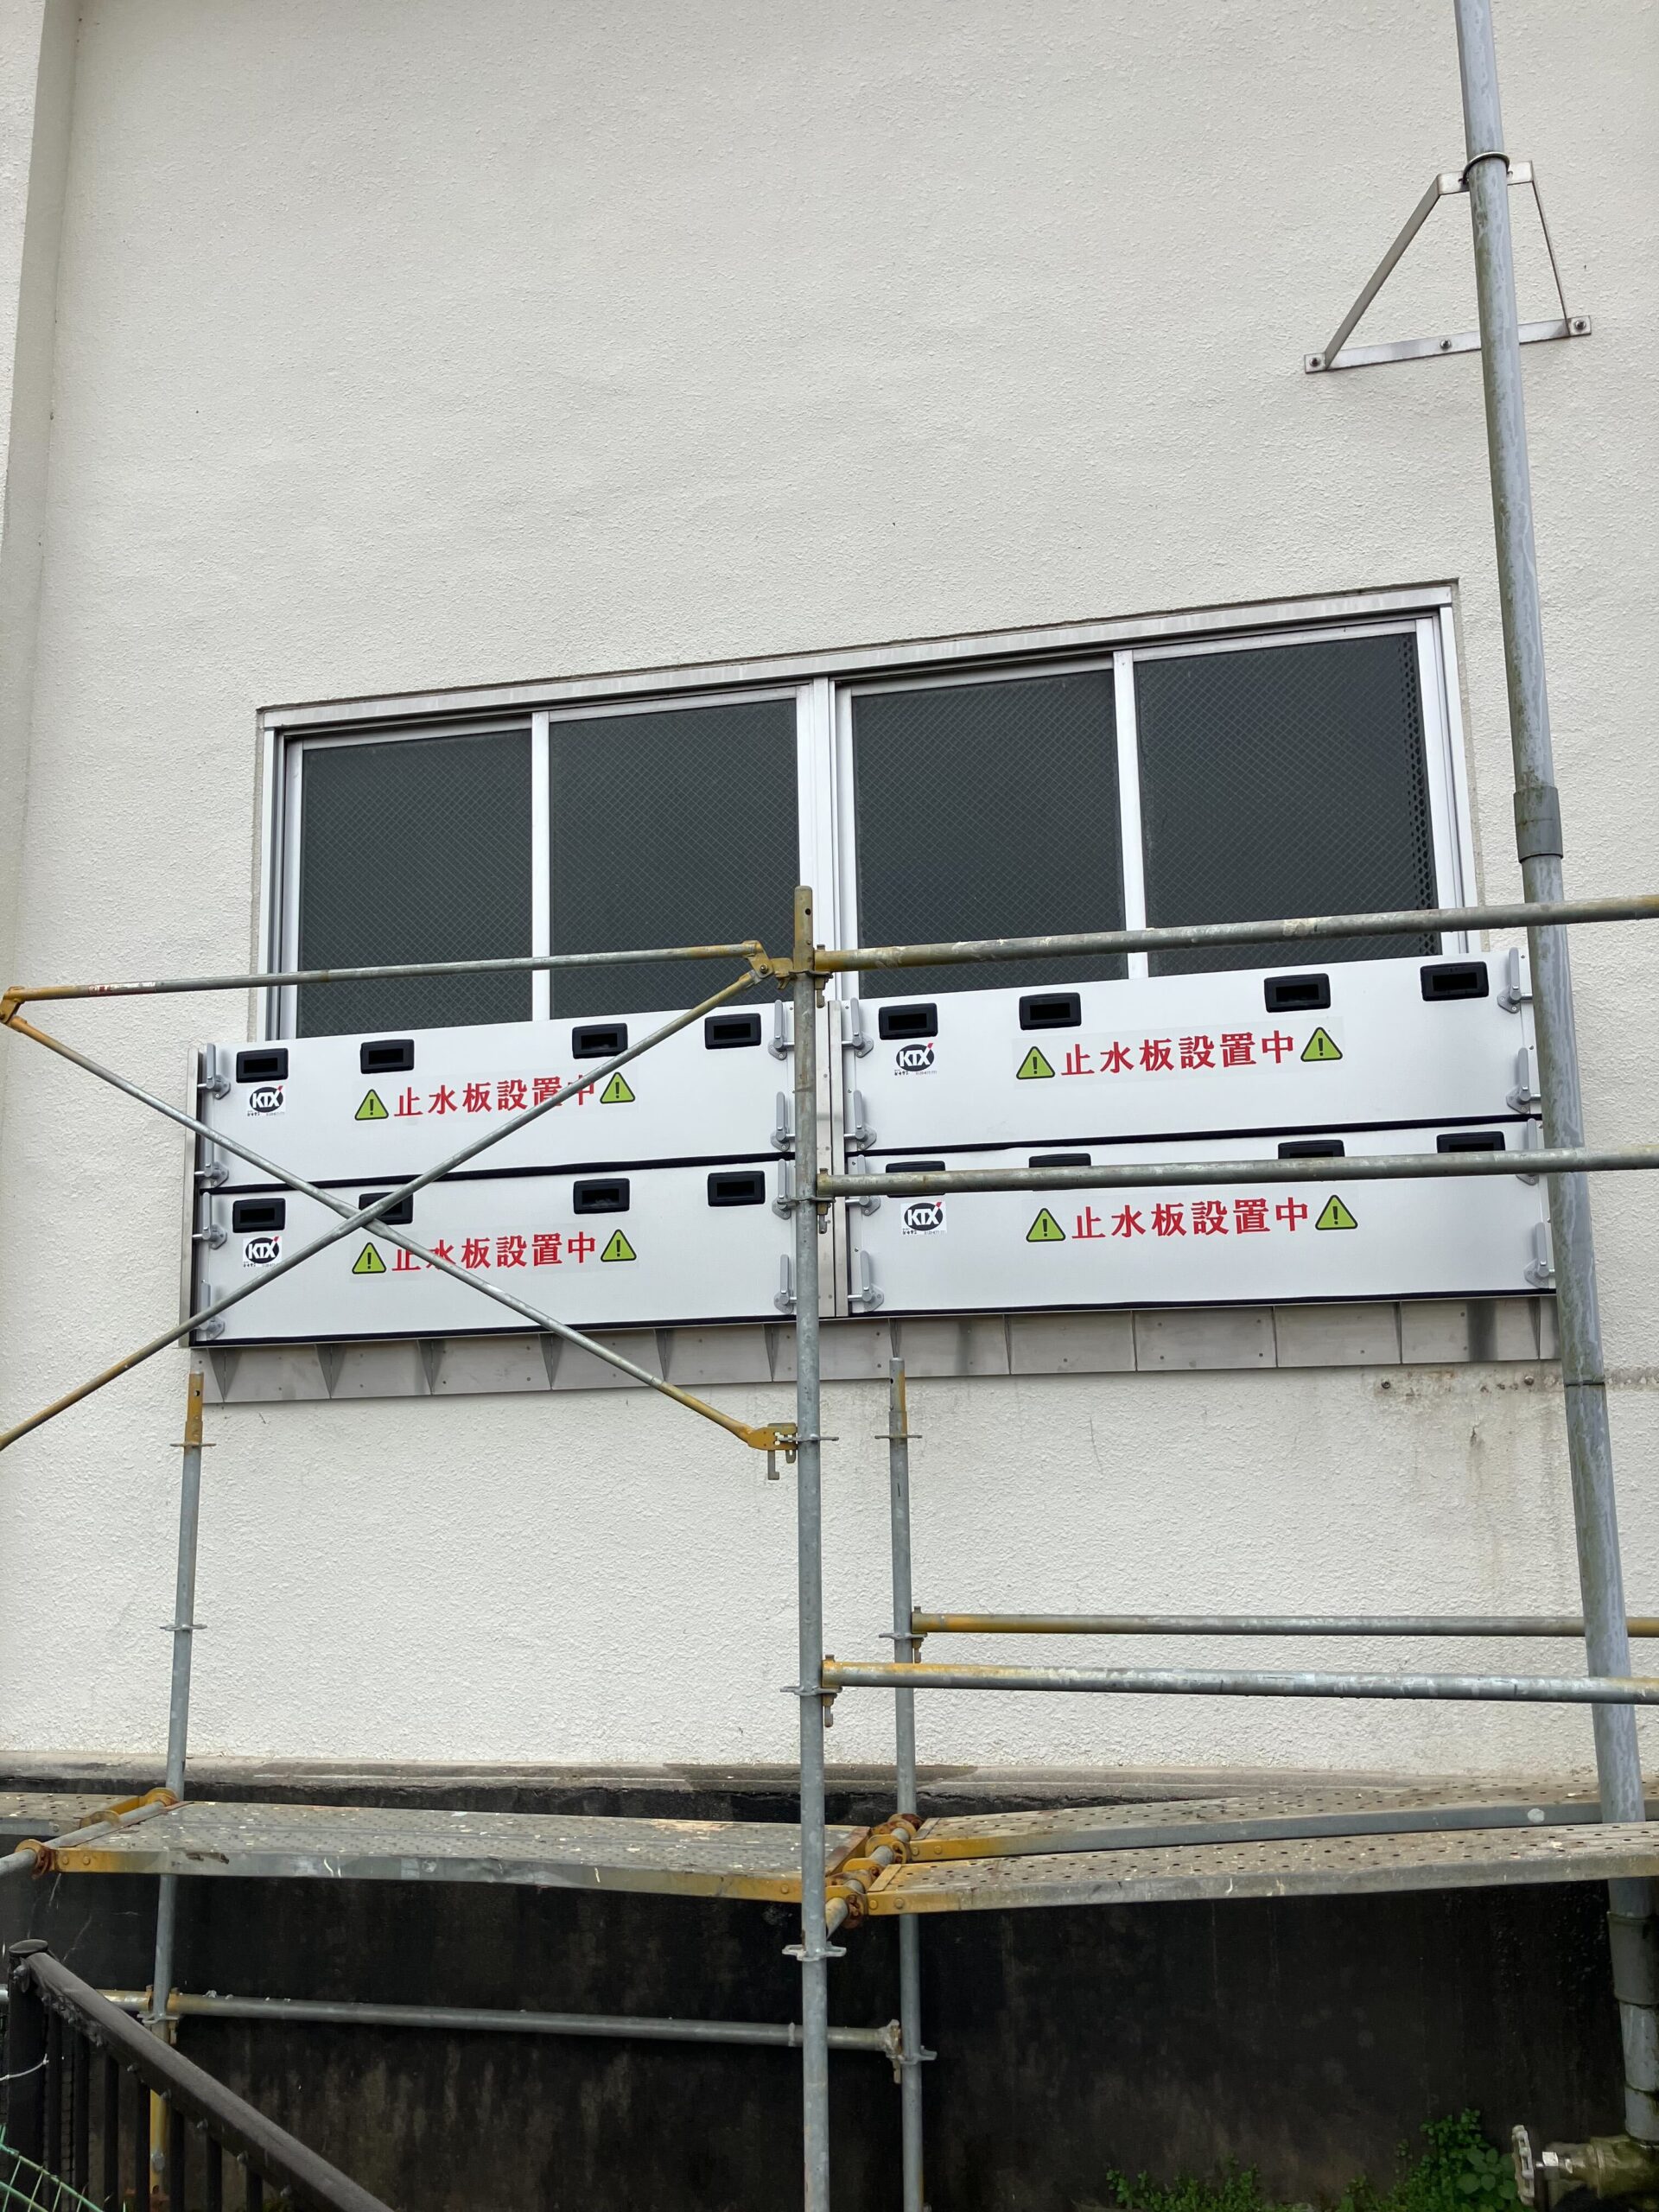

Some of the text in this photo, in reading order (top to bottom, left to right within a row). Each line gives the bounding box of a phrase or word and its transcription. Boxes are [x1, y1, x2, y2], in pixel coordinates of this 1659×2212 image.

[899, 1043, 934, 1066] KTX
[1060, 1030, 1294, 1076] 止水板設置中
[252, 1085, 283, 1109] KTX
[907, 1202, 942, 1225] KTX
[1072, 1197, 1308, 1240] 止水板設置中
[248, 1236, 279, 1259] KTX
[392, 1231, 595, 1272] 止水板設置中
